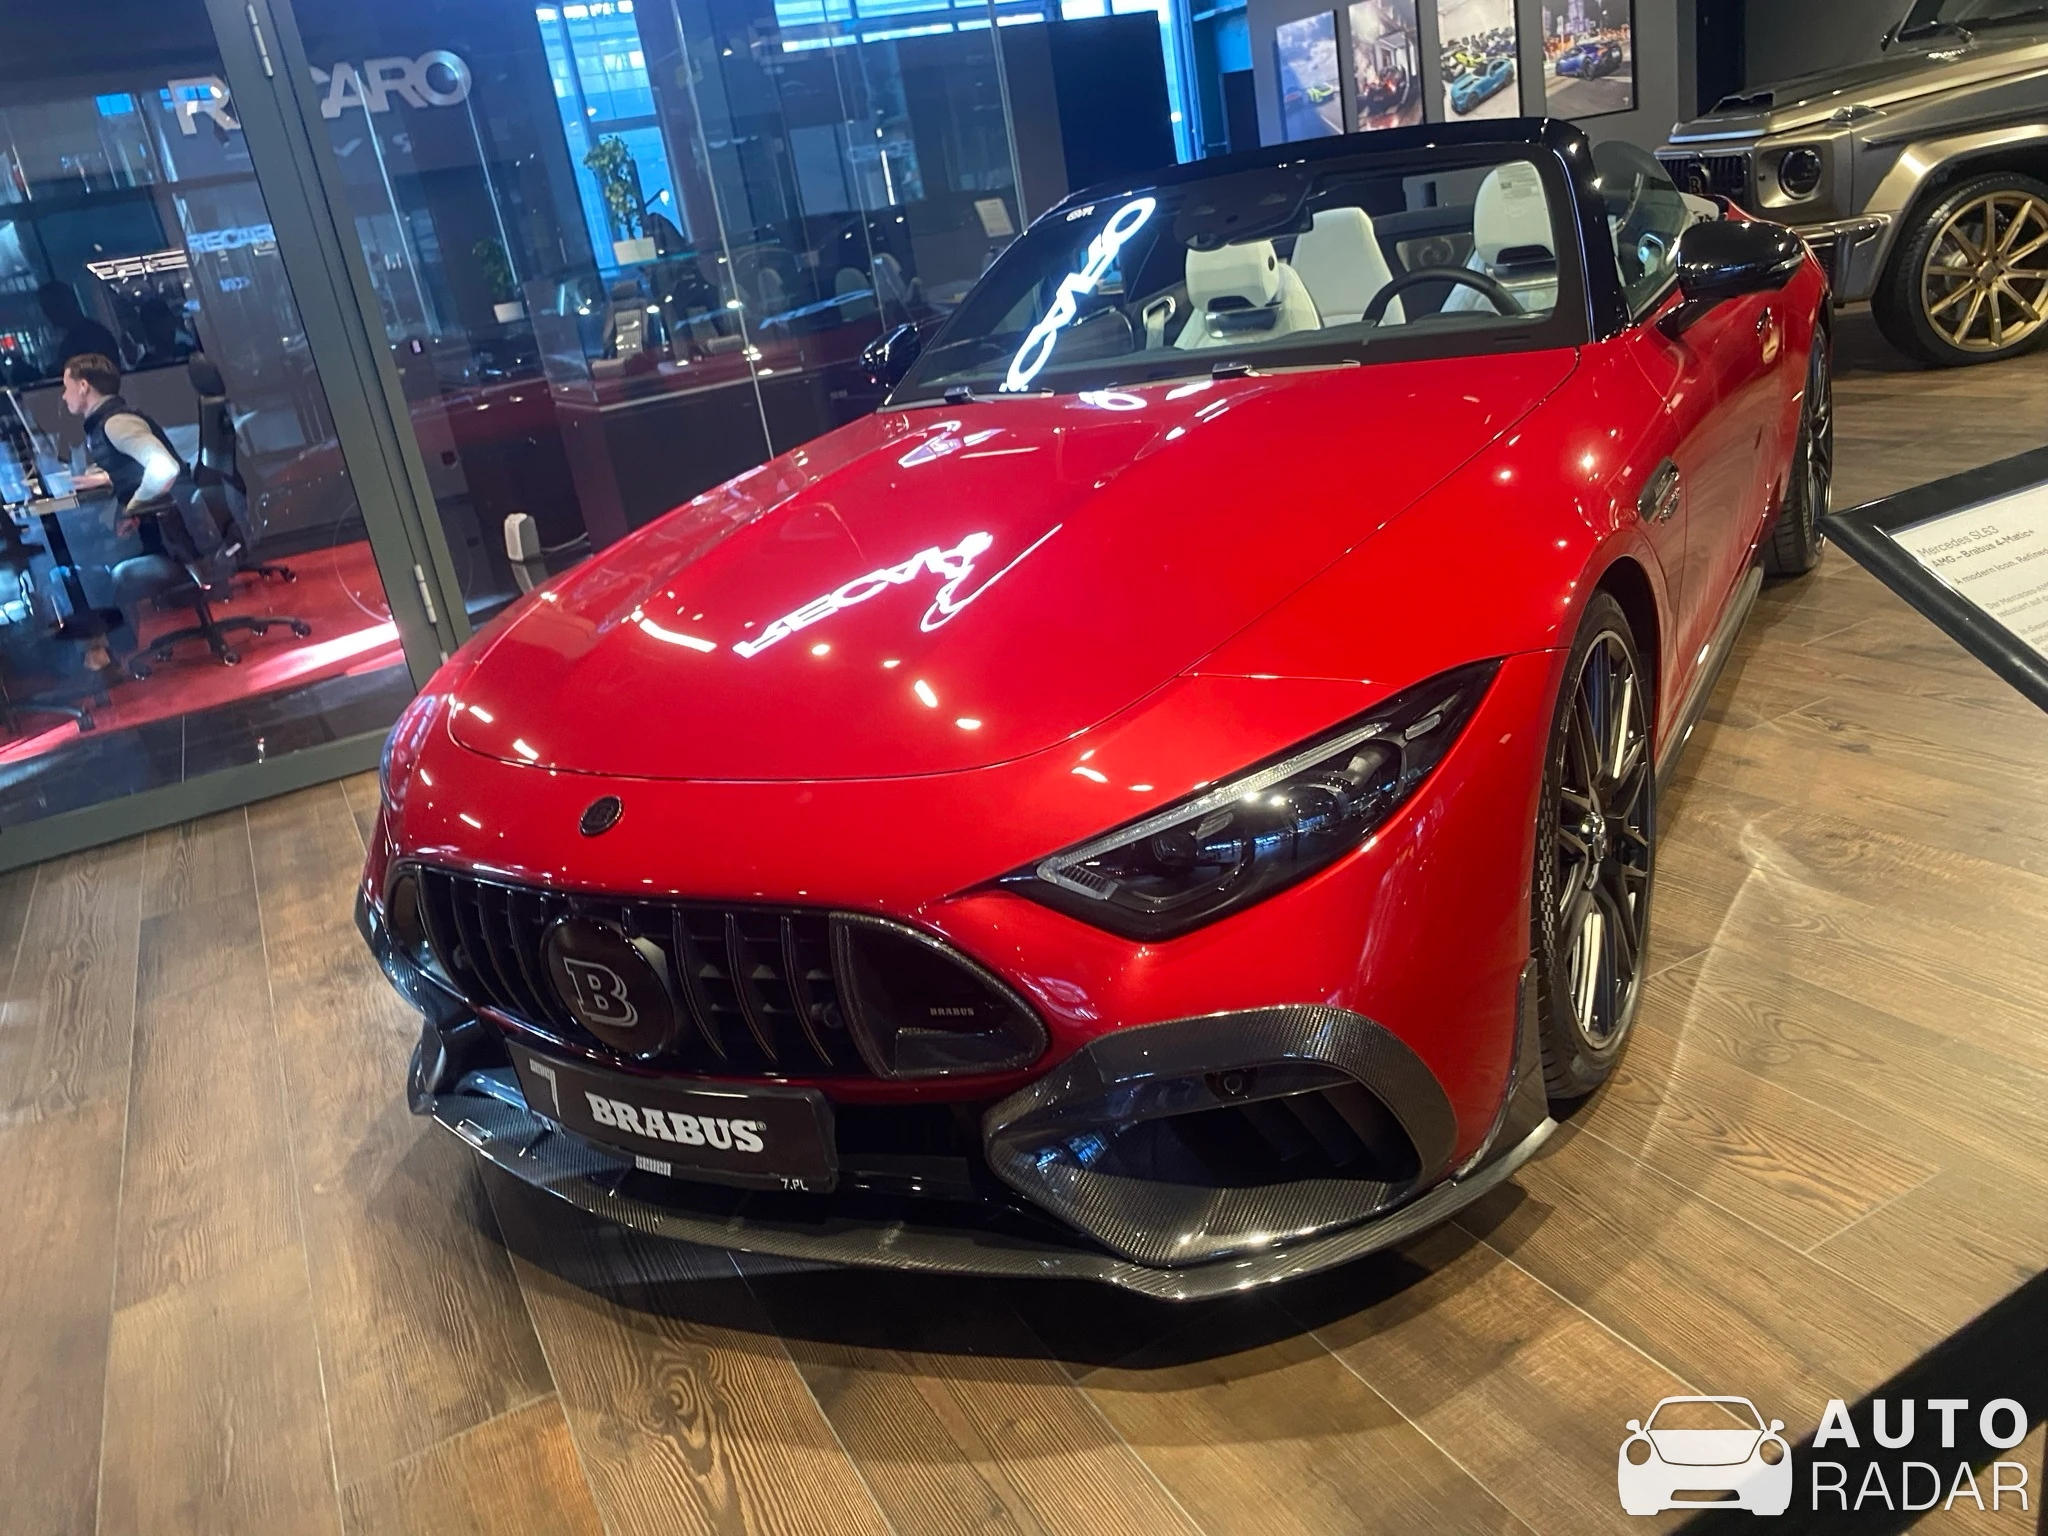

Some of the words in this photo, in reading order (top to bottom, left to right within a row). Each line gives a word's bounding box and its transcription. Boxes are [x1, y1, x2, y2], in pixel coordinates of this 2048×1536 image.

[1916, 534, 1973, 558] Mercedes
[1968, 525, 1999, 542] SL63
[1931, 555, 1956, 568] AMG
[1960, 543, 1997, 558] Brabus
[1954, 577, 1964, 585] A
[1962, 567, 1997, 582] modern
[563, 957, 639, 1028] B
[929, 1007, 975, 1016] BRABUS
[780, 1178, 809, 1192] 7.PL
